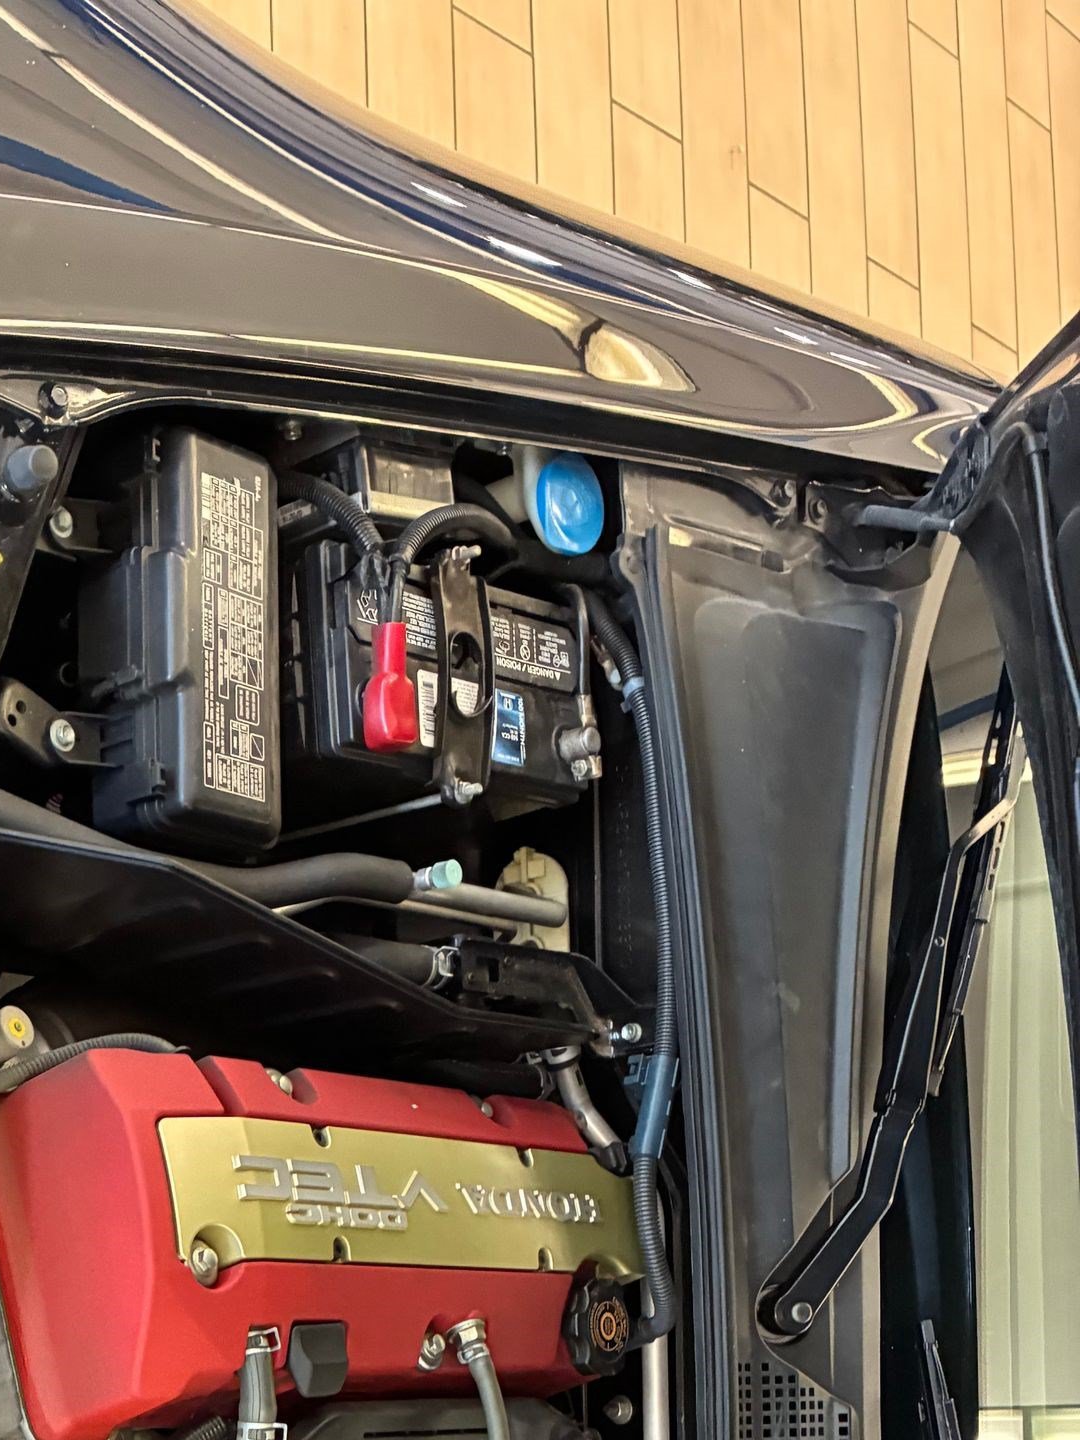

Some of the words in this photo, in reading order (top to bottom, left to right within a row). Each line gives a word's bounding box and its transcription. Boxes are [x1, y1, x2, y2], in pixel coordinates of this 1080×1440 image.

[496, 656, 522, 671] POISON
[526, 664, 555, 679] DANGER
[232, 1155, 448, 1211] VTEC
[285, 1204, 408, 1231] DOHC
[456, 1183, 602, 1225] HONDA
